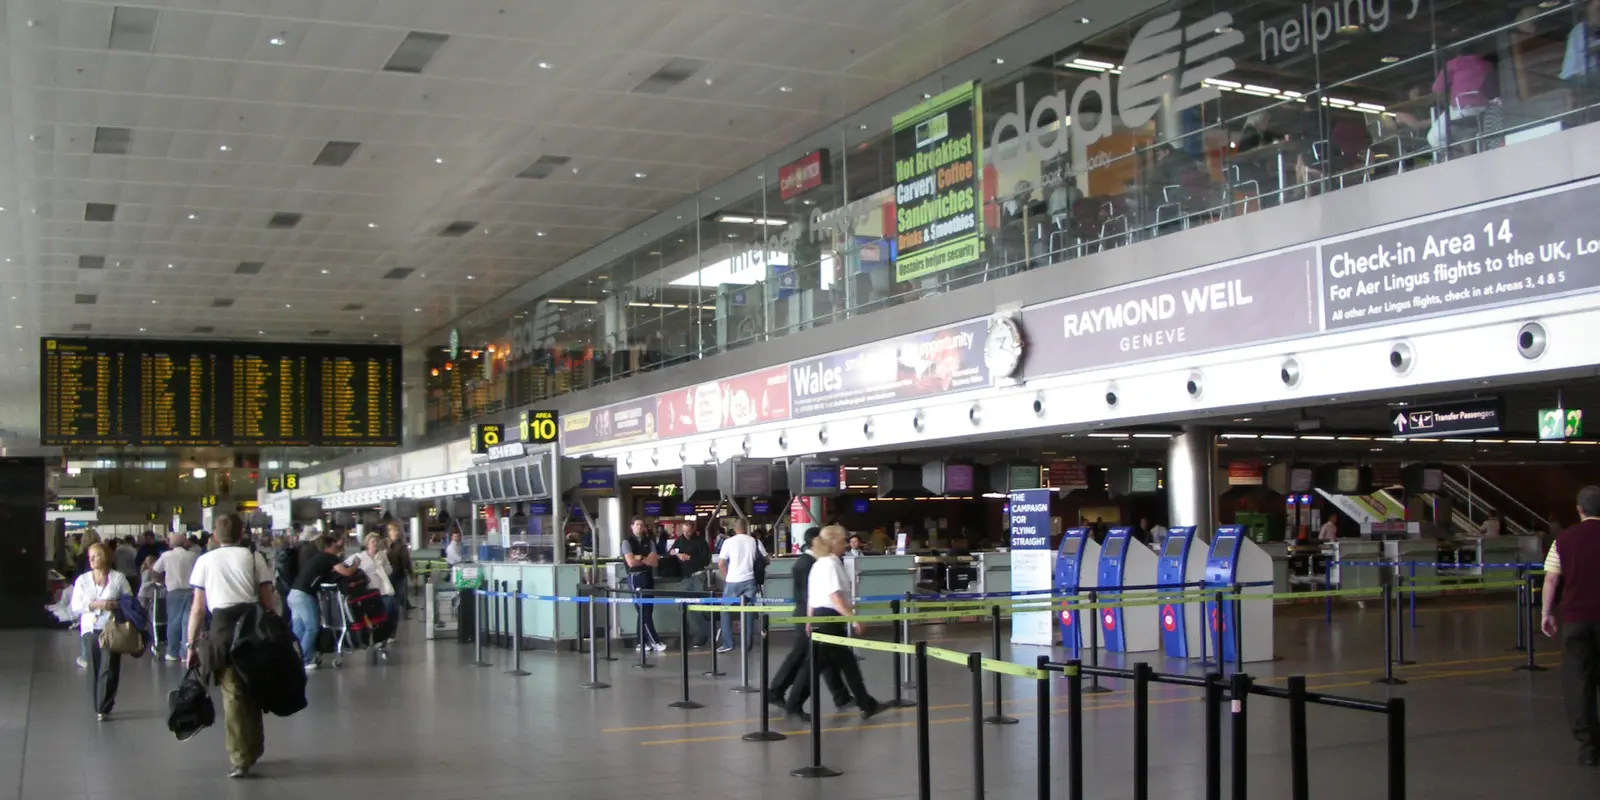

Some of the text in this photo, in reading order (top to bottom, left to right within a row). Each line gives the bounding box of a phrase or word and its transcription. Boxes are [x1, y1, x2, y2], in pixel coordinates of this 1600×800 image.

[1259, 0, 1392, 61] helping
[896, 156, 914, 182] Hot
[916, 132, 972, 174] Breakfast
[897, 160, 973, 205] Carvery Coffee
[898, 187, 974, 232] Sandwiches
[898, 213, 975, 251] Drinks & Smoothies
[899, 257, 925, 277] Upstairs
[947, 243, 976, 263] security
[1330, 218, 1513, 279] Check-in Area 14
[1330, 236, 1600, 302] For Aer Lingus flights to the UK, Lo
[1063, 279, 1253, 338] RAYMOND WEIL
[1332, 309, 1343, 322] All
[1344, 306, 1367, 320] other
[1367, 303, 1382, 316] Aer
[1384, 299, 1411, 314] Lingus
[1412, 293, 1443, 309] flights,
[1444, 288, 1470, 303] check
[1471, 286, 1482, 298] in
[1483, 284, 1494, 296] at
[1495, 280, 1524, 294] Areas
[1537, 275, 1545, 287] 4
[1546, 273, 1556, 285] &
[1557, 271, 1566, 283] 5
[1119, 327, 1187, 352] GENEVE
[793, 362, 843, 397] Wales
[530, 419, 556, 440] 10
[1434, 411, 1495, 422] Transfer Passengers
[484, 431, 499, 449] 9
[271, 481, 280, 492] 7
[287, 477, 297, 489] 8
[1011, 493, 1026, 502] THE
[1011, 503, 1048, 513] CAMPAIGN
[1011, 515, 1027, 524] FOR
[1011, 526, 1037, 535] FLYING
[1012, 537, 1046, 546] STRAIGHT
